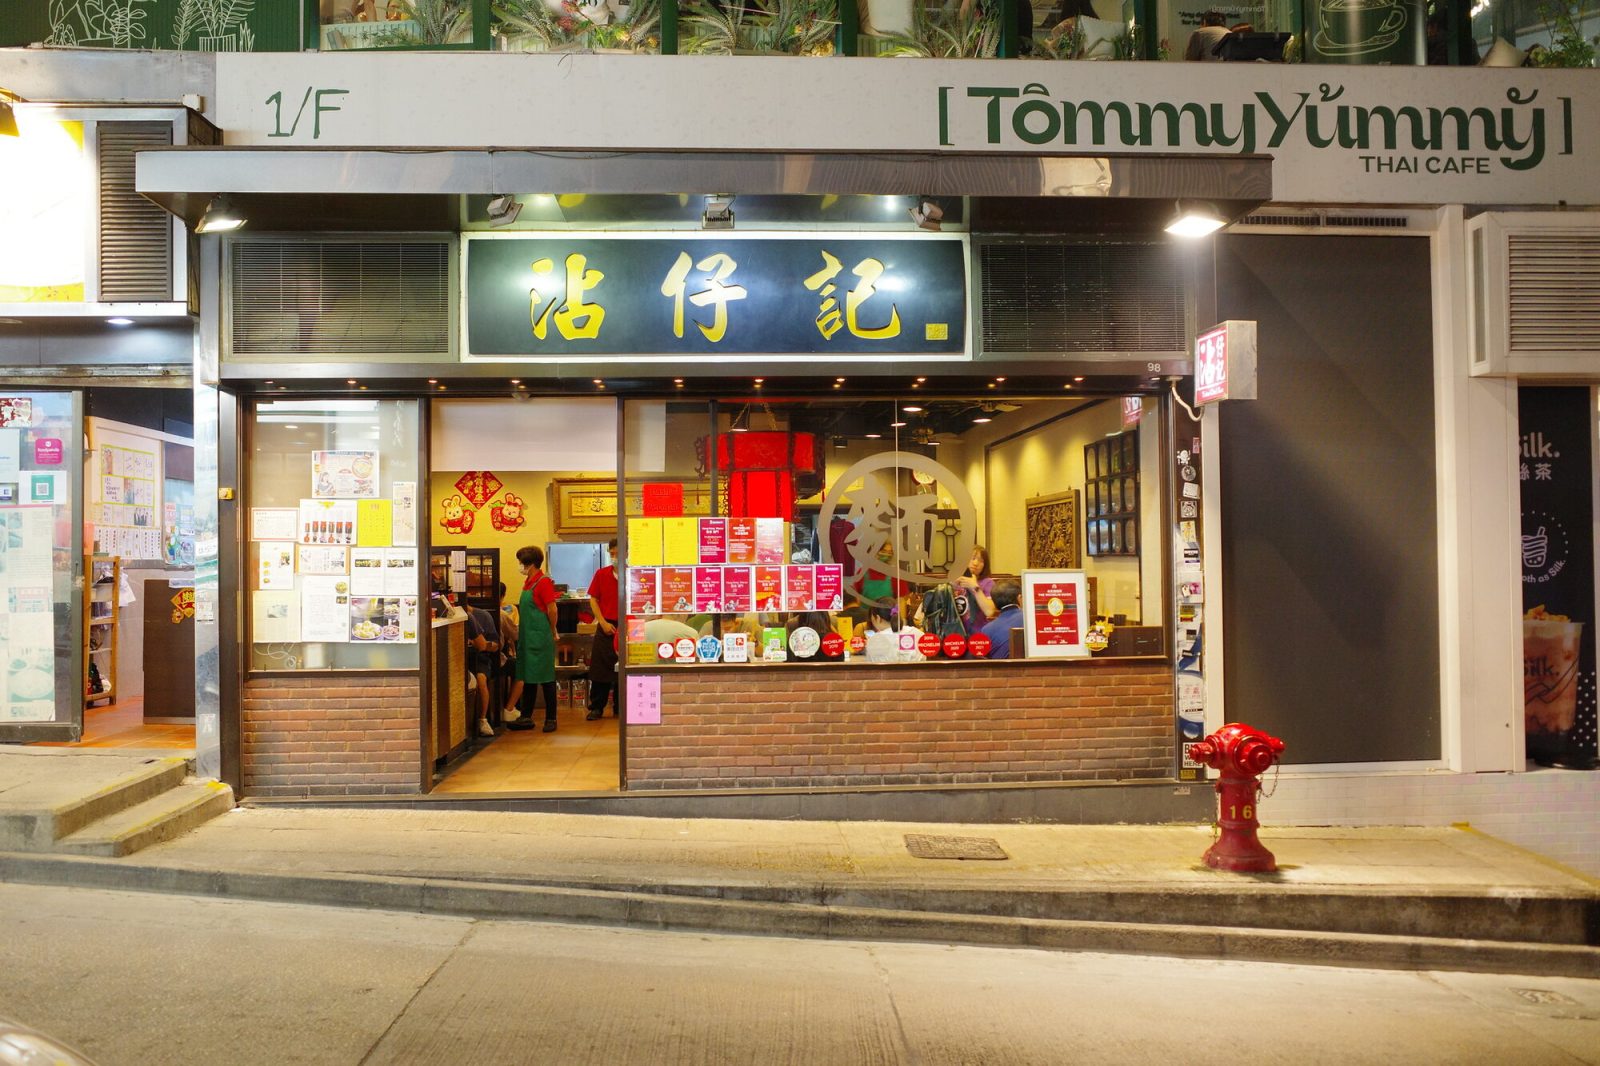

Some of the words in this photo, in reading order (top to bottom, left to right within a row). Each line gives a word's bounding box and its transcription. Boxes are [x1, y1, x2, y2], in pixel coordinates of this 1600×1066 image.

[265, 86, 350, 139] 1/F
[1359, 156, 1418, 173] THAI
[1426, 157, 1490, 174] CAFE
[530, 250, 901, 343] 沾仔記
[1147, 362, 1161, 372] 98
[1519, 432, 1560, 458] ilk.
[1538, 574, 1549, 582] as
[1230, 805, 1252, 819] 16
